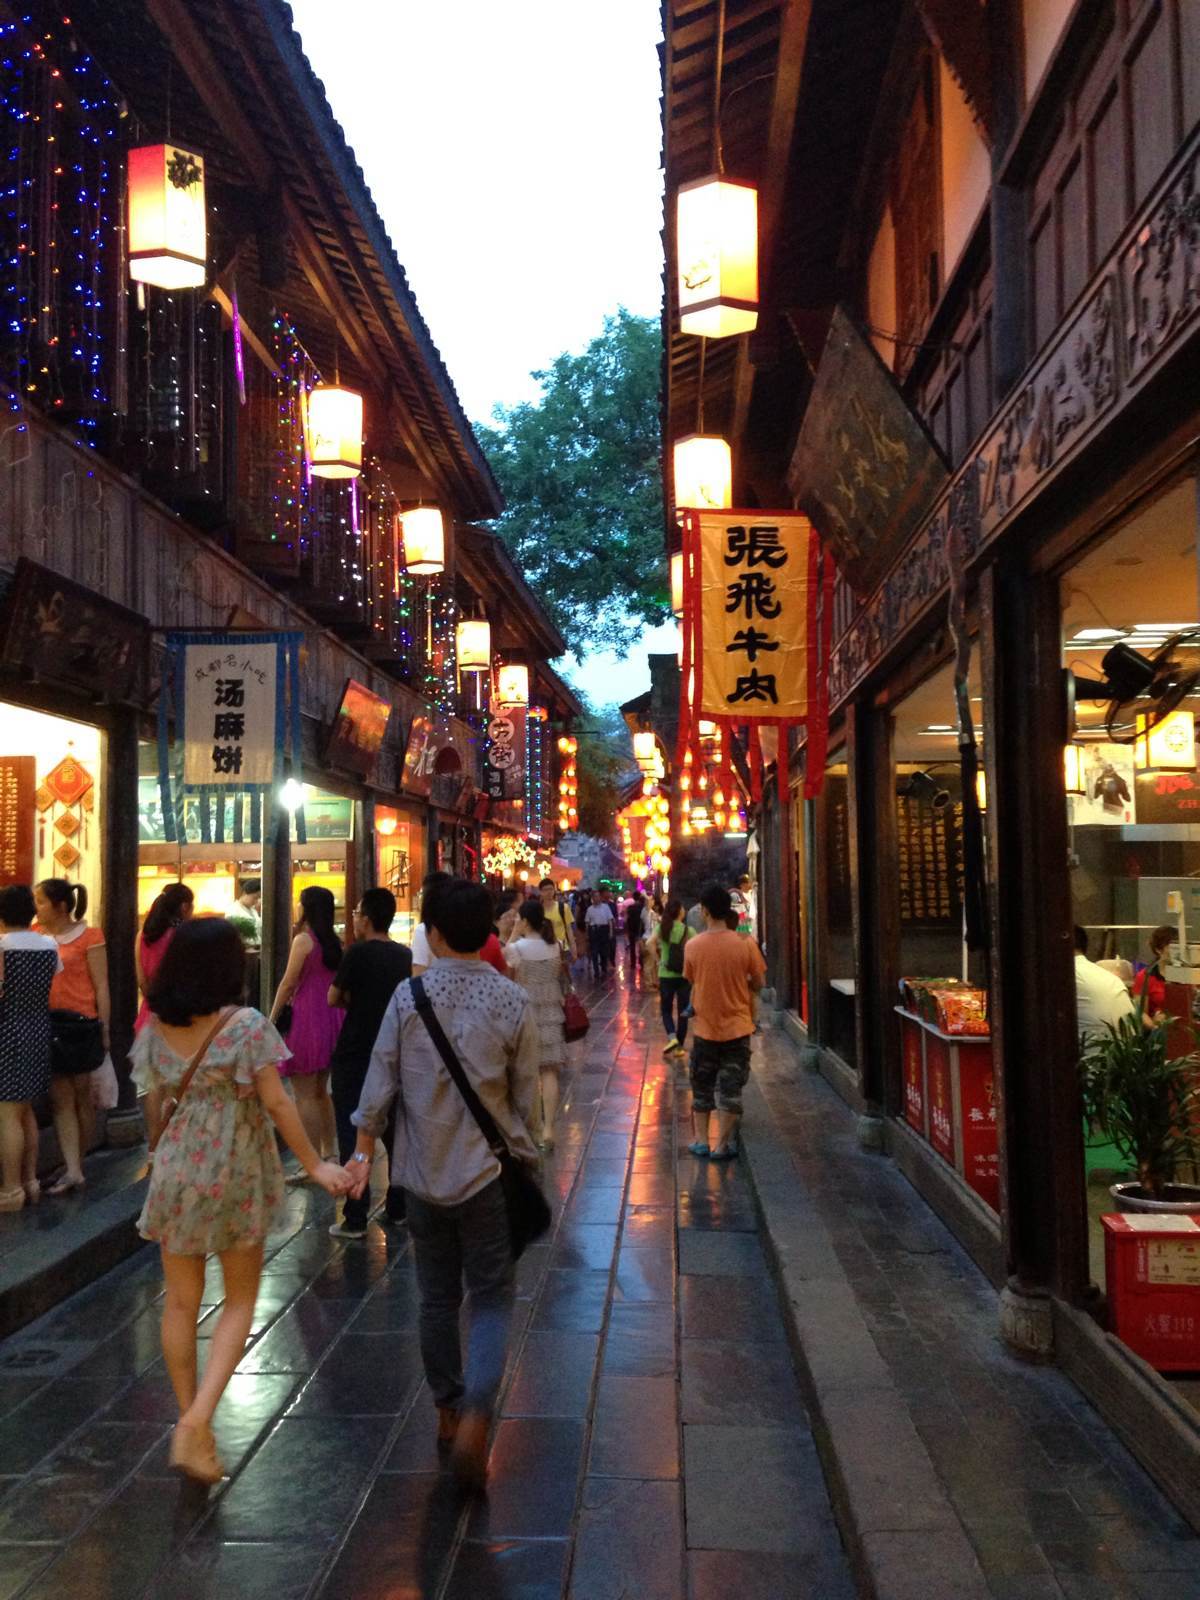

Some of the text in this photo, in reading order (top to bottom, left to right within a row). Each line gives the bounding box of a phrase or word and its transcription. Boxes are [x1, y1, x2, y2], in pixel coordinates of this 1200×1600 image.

[724, 526, 788, 705] 張飛牛肉
[195, 653, 268, 685] 成都名小吃
[212, 678, 245, 774] 汤麻饼
